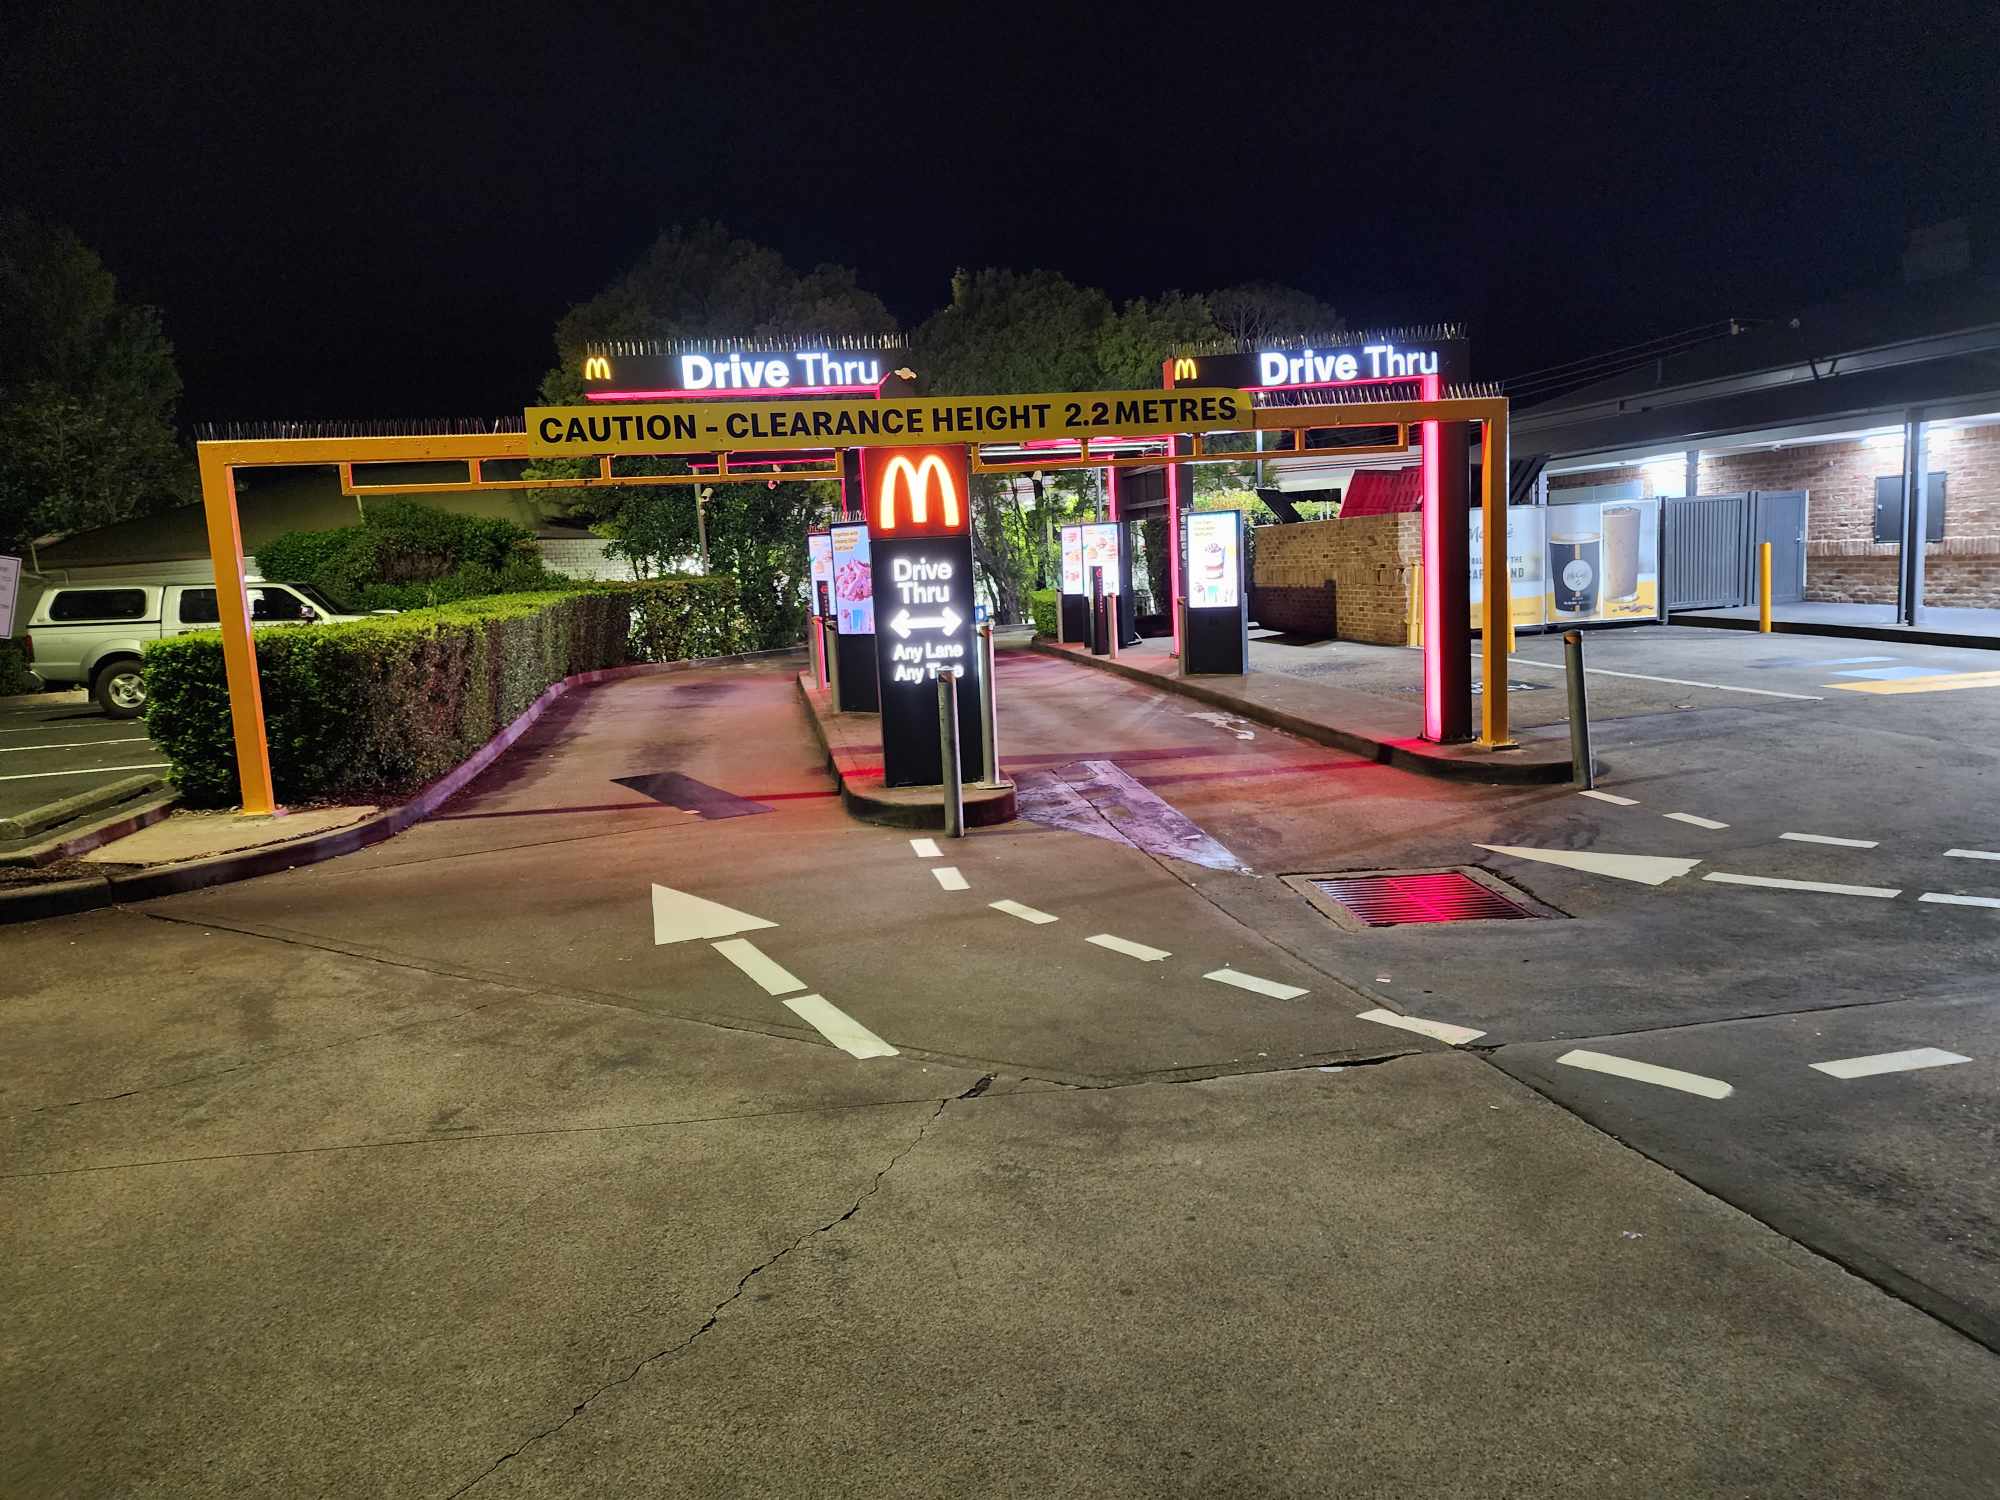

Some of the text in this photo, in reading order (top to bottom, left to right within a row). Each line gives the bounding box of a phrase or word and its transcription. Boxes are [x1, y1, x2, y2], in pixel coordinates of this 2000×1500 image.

[681, 352, 881, 389] Drive Thru
[1260, 344, 1440, 386] Drive Thru
[540, 414, 697, 443] CAUTION
[726, 408, 924, 439] CLEARANCE
[932, 403, 1052, 432] HEIGHT
[1065, 402, 1109, 427] 2.2
[1114, 396, 1237, 424] METRES
[893, 557, 953, 582] Drive
[896, 582, 950, 605] Thru
[892, 642, 964, 663] Any Lane
[894, 664, 924, 685] Any
